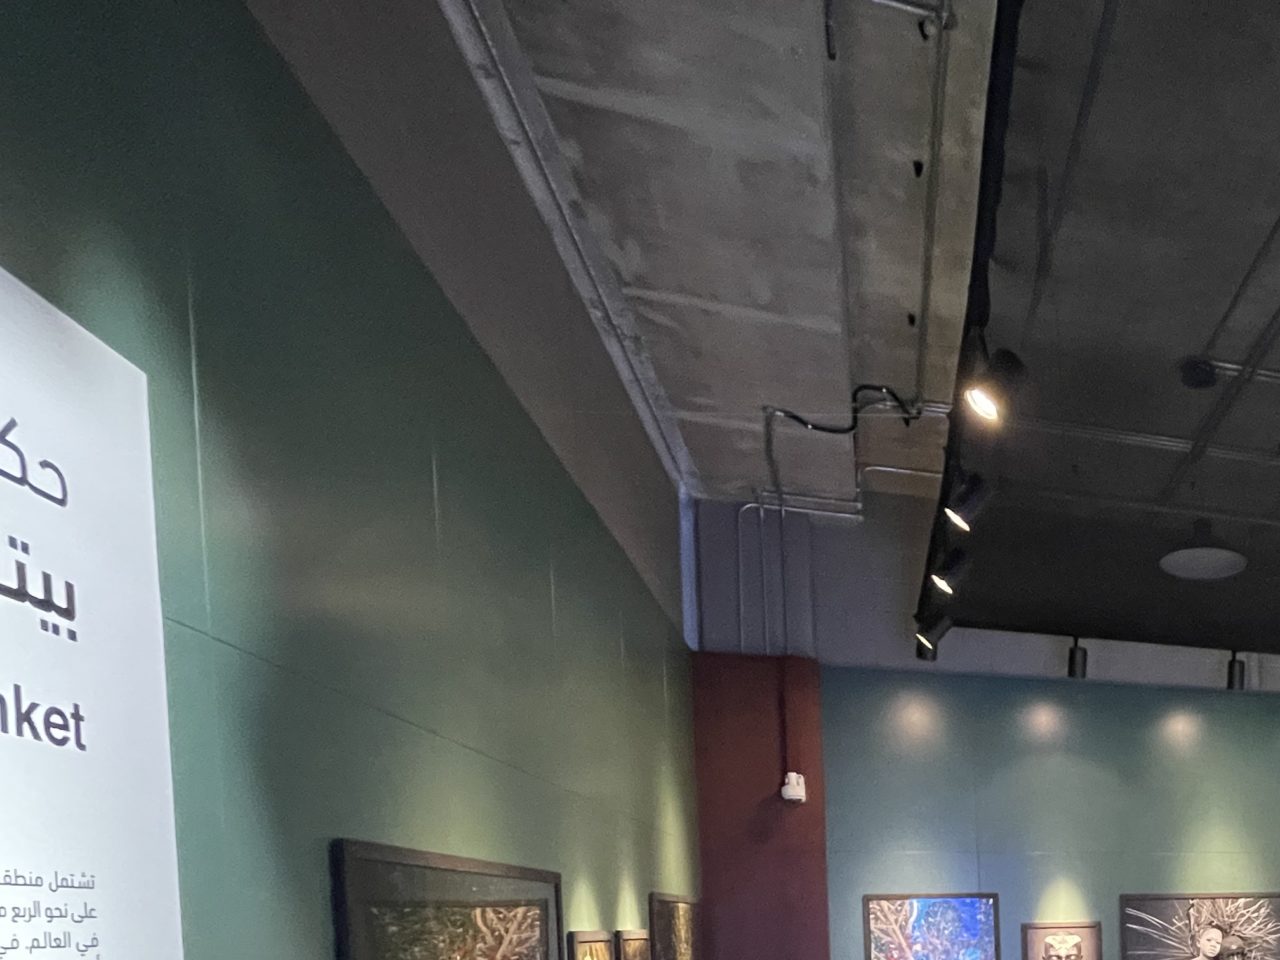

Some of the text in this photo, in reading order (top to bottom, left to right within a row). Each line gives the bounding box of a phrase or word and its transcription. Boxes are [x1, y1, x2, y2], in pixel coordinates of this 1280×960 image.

[48, 871, 96, 892] تشتمل
[11, 900, 41, 923] الربع
[45, 903, 68, 923] نحو
[71, 901, 98, 923] على
[76, 932, 99, 957] في
